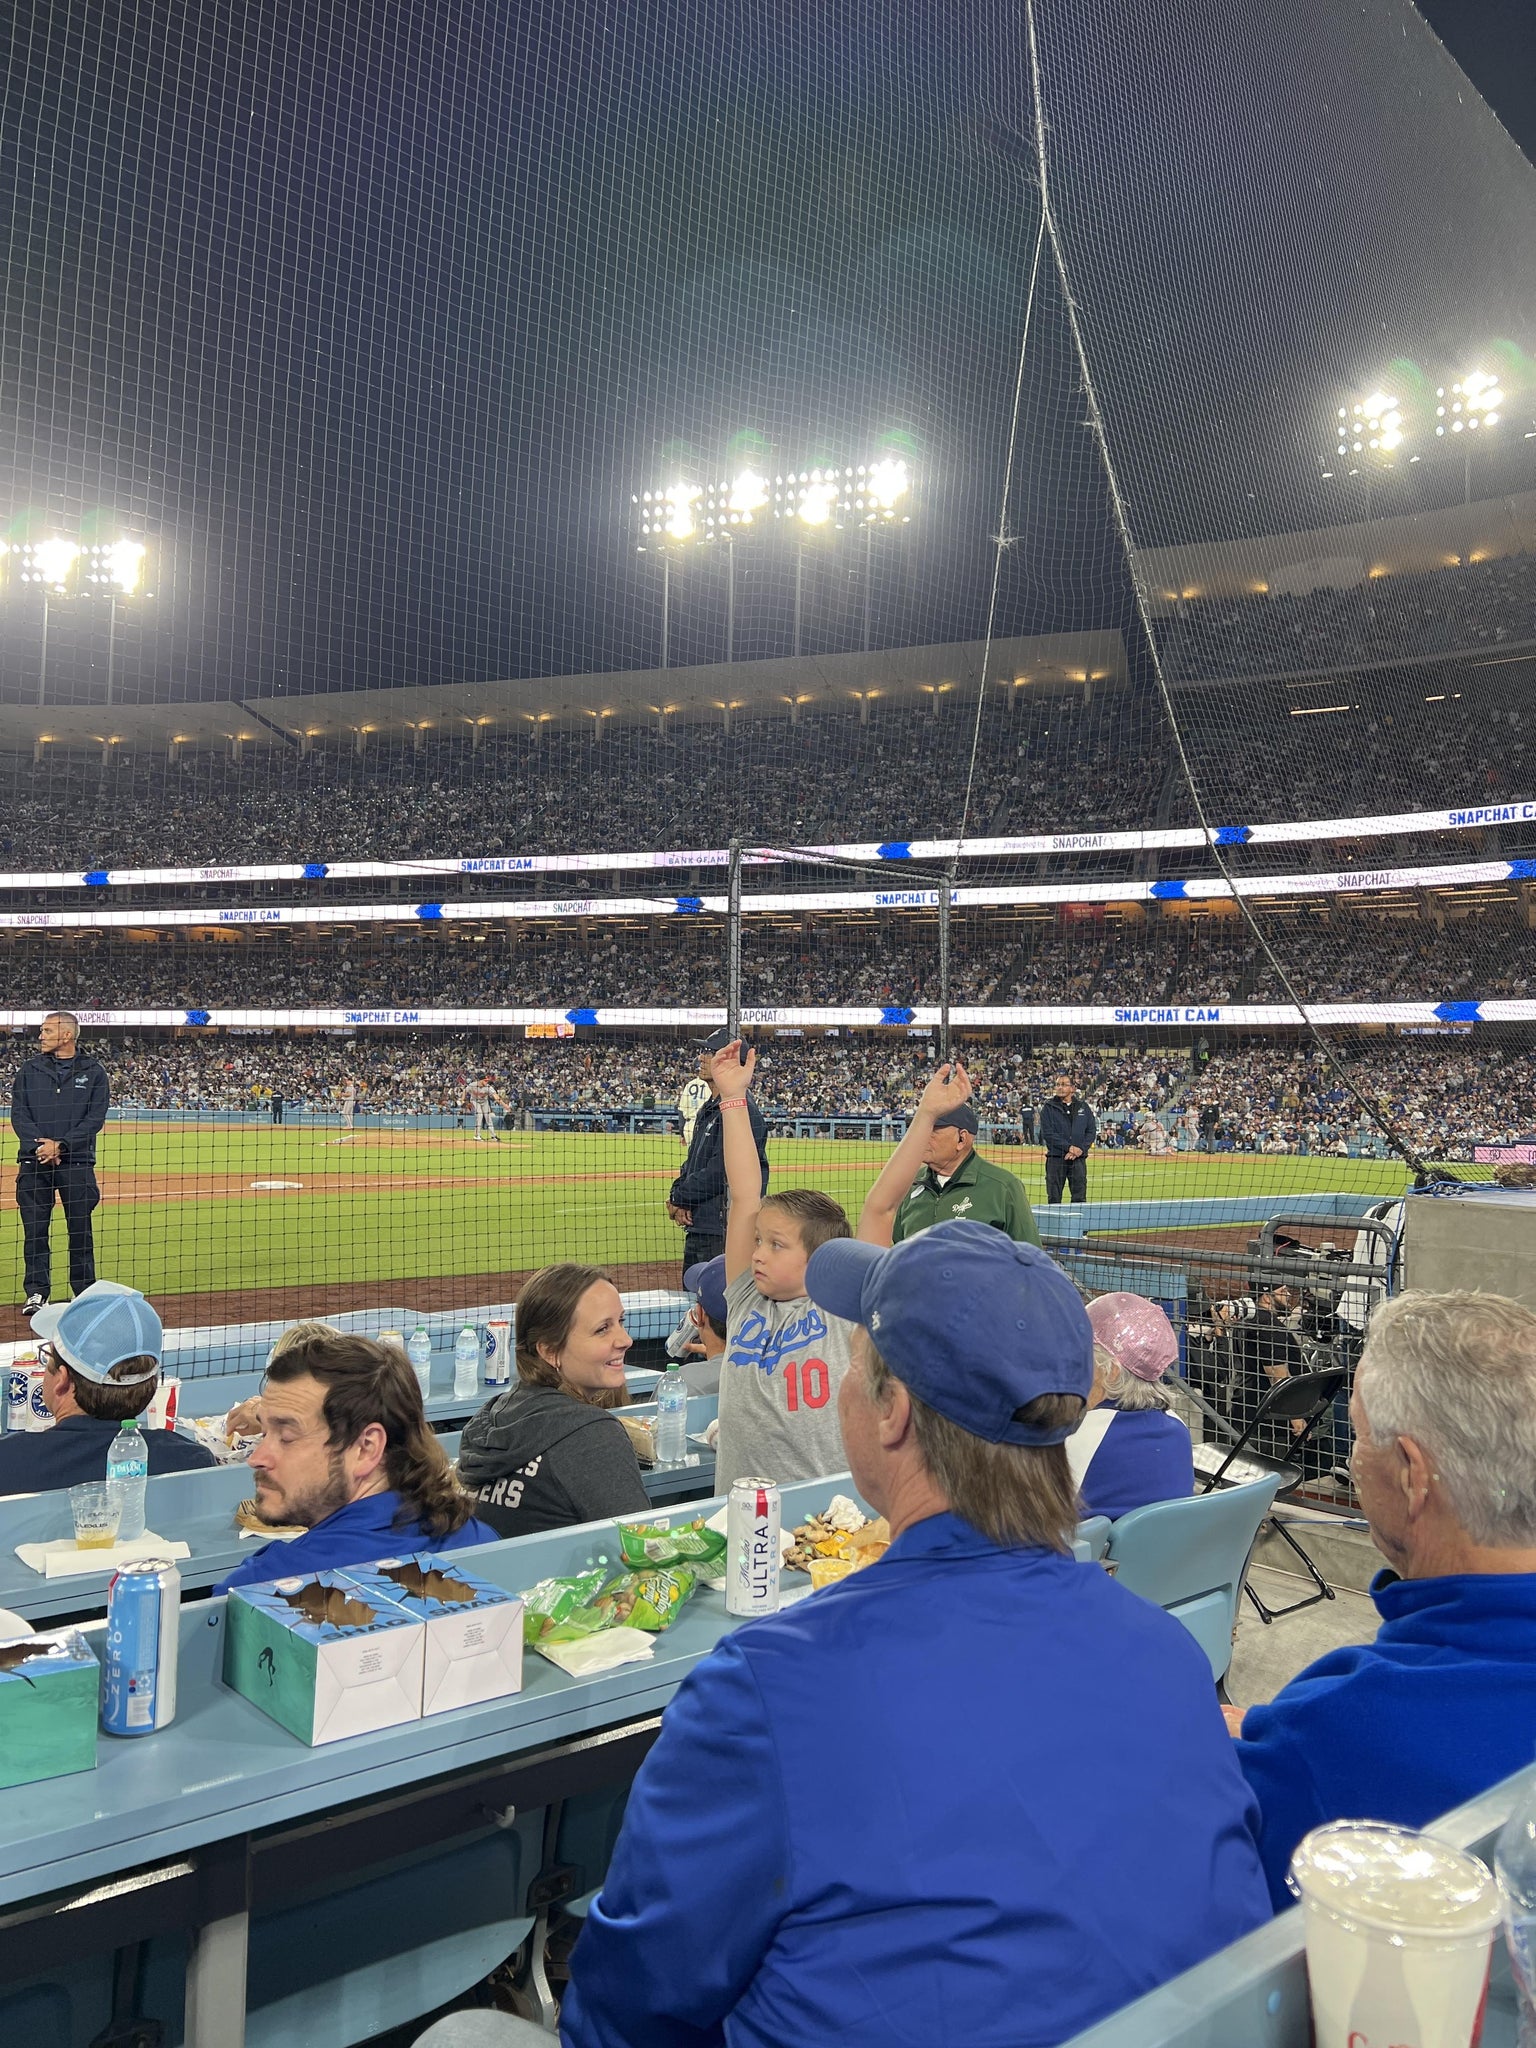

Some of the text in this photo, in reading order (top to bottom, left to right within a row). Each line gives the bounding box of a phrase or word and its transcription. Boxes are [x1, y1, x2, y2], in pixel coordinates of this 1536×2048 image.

[1449, 807, 1517, 825] SNAPCHAT
[1052, 836, 1103, 849] SNAPCHAT
[461, 859, 532, 871] SNAPCHAT CAM
[669, 857, 693, 865] BANK
[200, 869, 234, 879] SNAPCHAT
[1337, 872, 1392, 888] SNAPCHAT
[876, 891, 958, 905] SNAPCHAT CM
[553, 901, 592, 913] SNAPCHAT
[17, 915, 50, 925] SNAPCHAT
[219, 910, 280, 921] SNAPCHAT CAM
[345, 1012, 418, 1023] SNAPCHAT CAM
[1115, 1009, 1219, 1022] SNAPCHAT CAM
[689, 1083, 706, 1099] 91
[783, 1358, 830, 1412] 10
[753, 1525, 768, 1598] ULTRA
[769, 1535, 777, 1585] ZERO
[429, 1596, 508, 1617] SHAQ
[321, 1617, 414, 1642] SHAQ
[111, 1631, 122, 1695] ZERO
